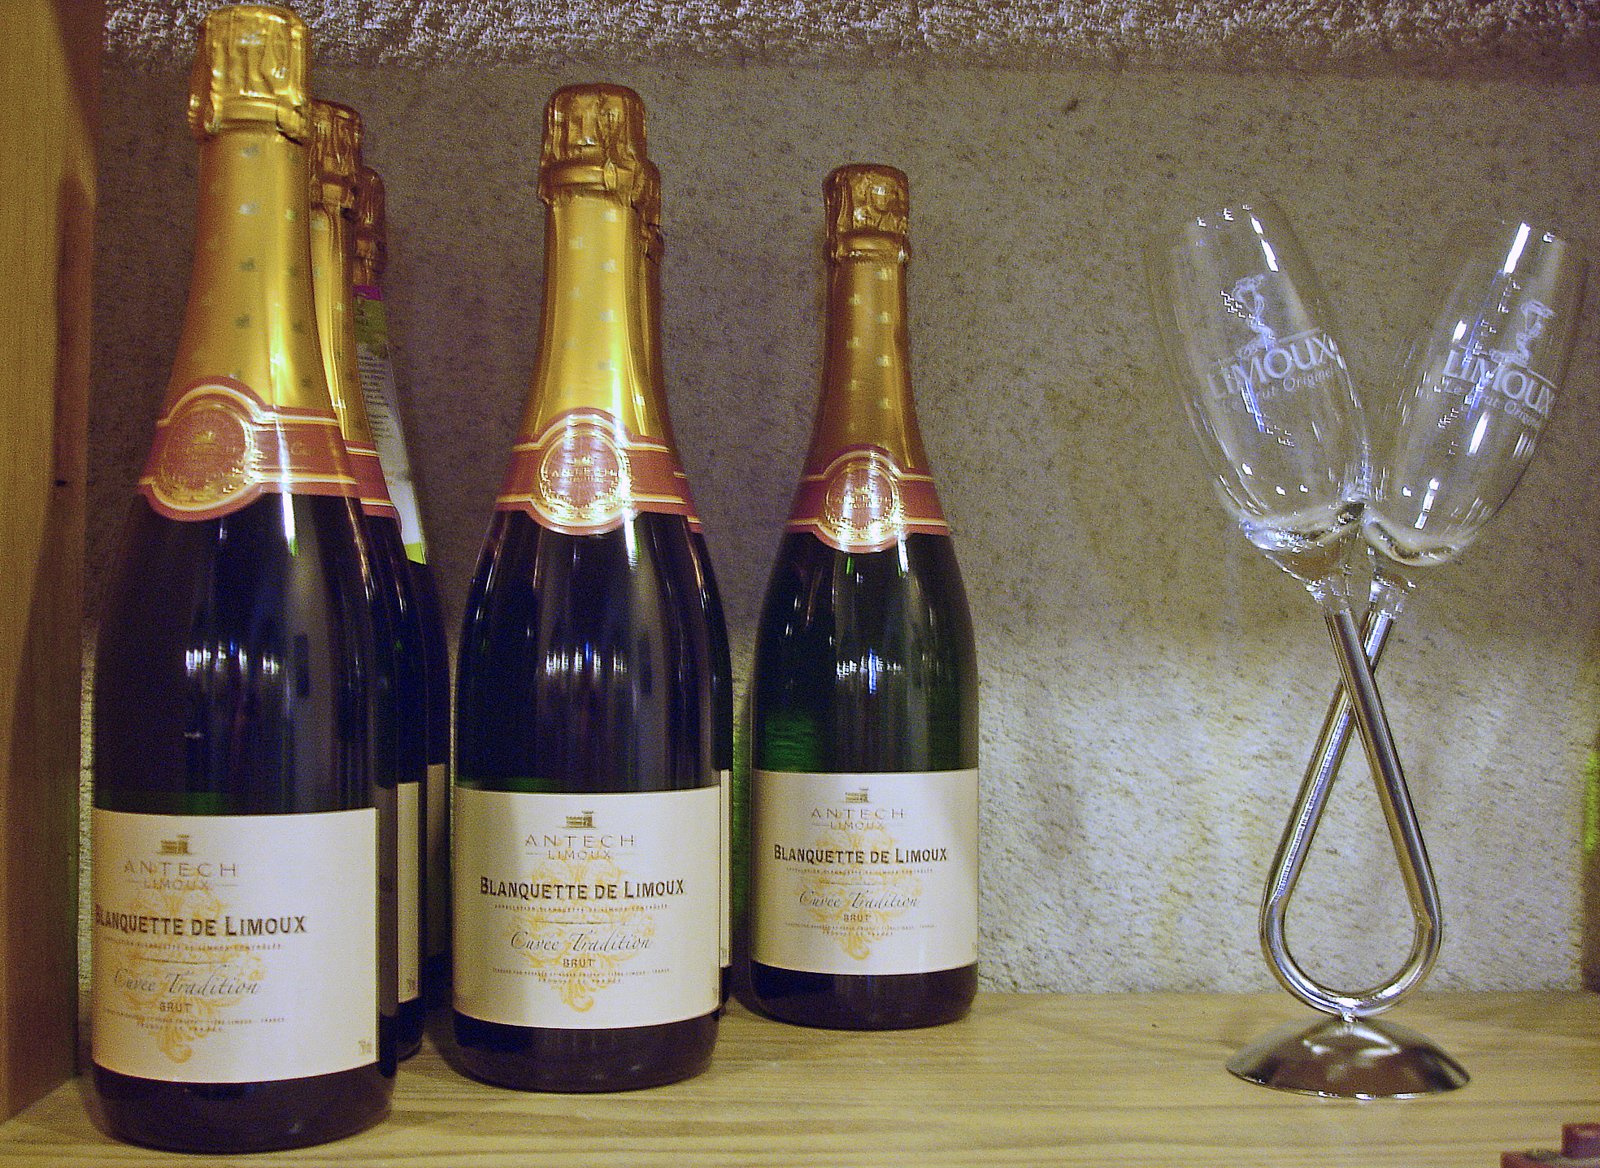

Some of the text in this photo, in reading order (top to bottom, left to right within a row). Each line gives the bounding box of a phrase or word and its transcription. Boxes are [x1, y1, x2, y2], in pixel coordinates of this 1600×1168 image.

[1206, 333, 1337, 398] LIMOUX
[811, 808, 905, 819] ANTECH
[830, 821, 884, 830] LIMOUX
[525, 834, 636, 849] ANTECH
[547, 850, 612, 860] LIMOUX
[870, 851, 889, 864] DE
[123, 861, 238, 878] ANTECH
[143, 879, 211, 891] LIMOUX
[595, 884, 618, 899] DE
[848, 889, 920, 909] Tradition
[843, 914, 872, 923] BRUT
[190, 918, 217, 936] DE
[568, 928, 653, 952] Tradition
[562, 958, 596, 968] BRUT
[165, 969, 260, 996] Tradition
[159, 1001, 193, 1013] BRUT
